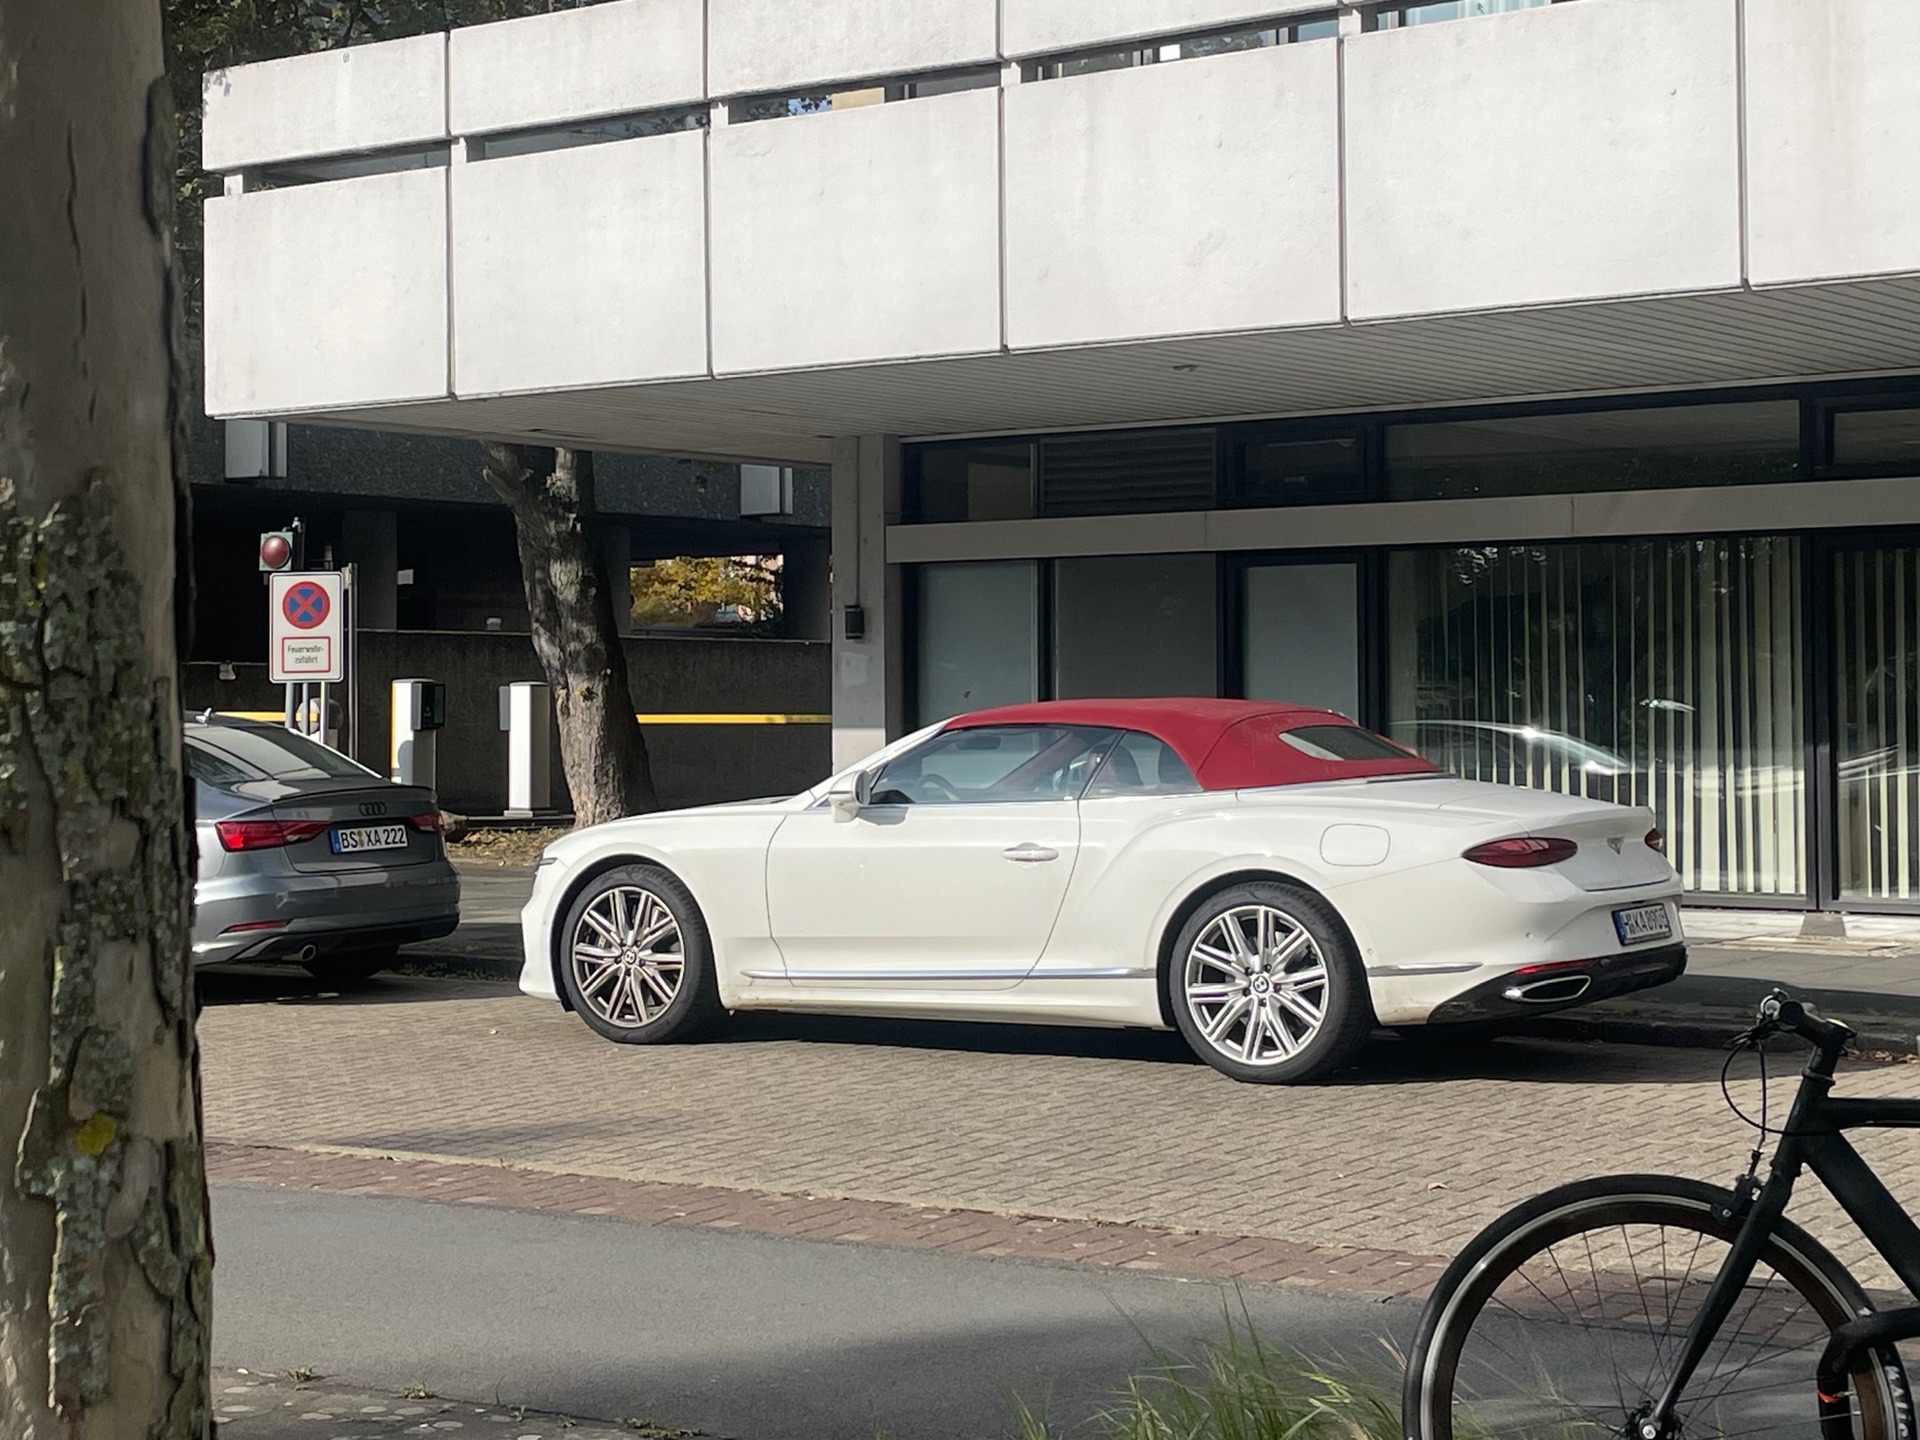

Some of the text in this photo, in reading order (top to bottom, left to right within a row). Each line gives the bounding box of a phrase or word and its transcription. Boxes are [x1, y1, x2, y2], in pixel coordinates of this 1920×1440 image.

[341, 827, 406, 849] BS XA 222
